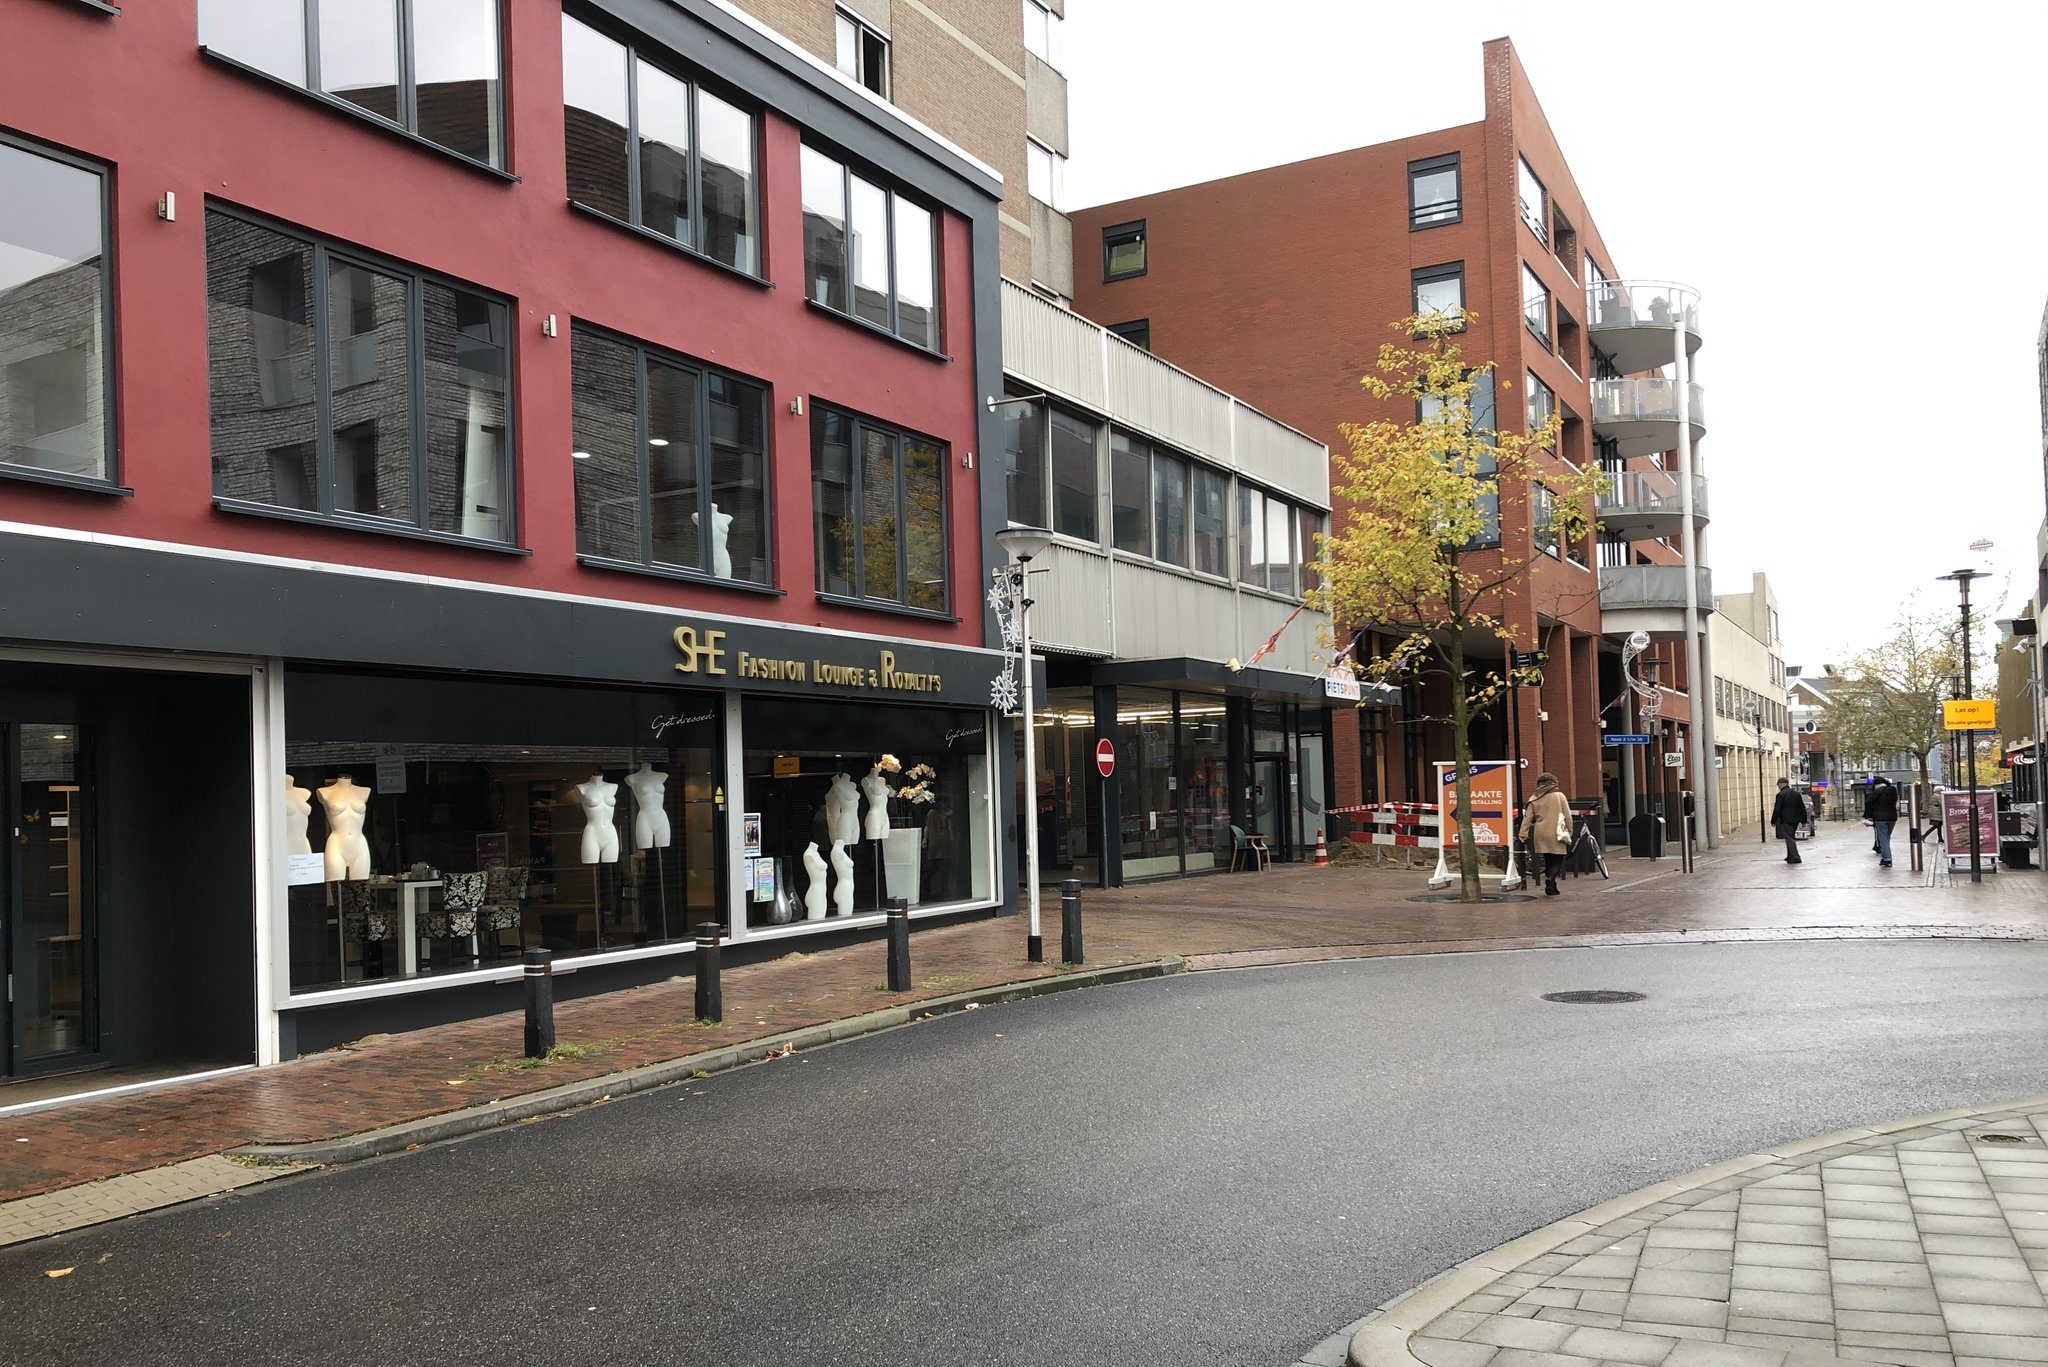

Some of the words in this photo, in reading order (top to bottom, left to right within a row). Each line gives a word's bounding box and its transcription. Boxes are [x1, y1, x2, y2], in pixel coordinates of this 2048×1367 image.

[674, 626, 726, 674] SHE
[738, 652, 805, 681] FASHION
[812, 659, 864, 687] LOUNGE
[868, 669, 878, 688] &
[880, 650, 941, 692] ROYALTY'S
[651, 714, 677, 739] Get
[1444, 765, 1478, 782] GRIS
[1448, 790, 1503, 798] BAAKTE
